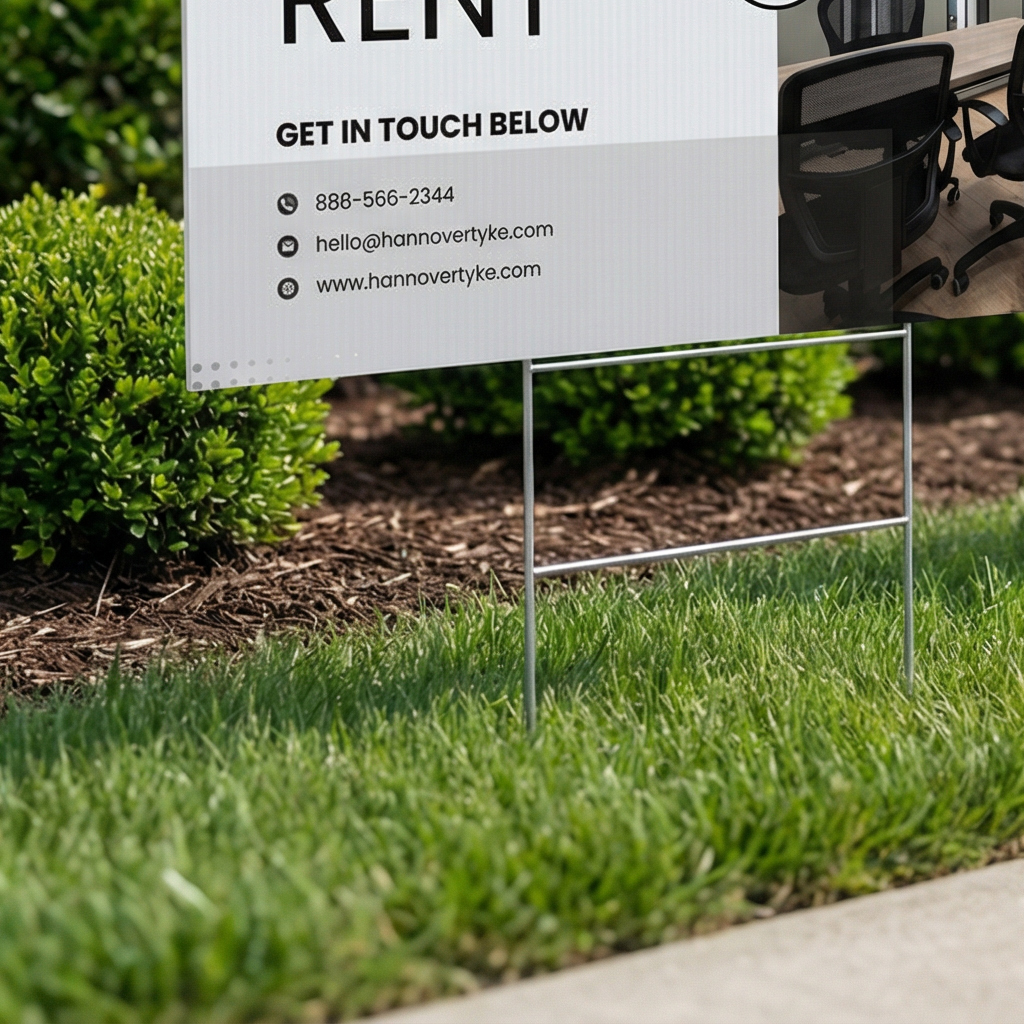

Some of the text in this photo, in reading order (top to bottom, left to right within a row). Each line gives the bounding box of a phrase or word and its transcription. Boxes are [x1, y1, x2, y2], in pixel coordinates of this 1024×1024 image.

[276, 107, 589, 148] GET IN TOUCH BELOW
[315, 185, 455, 212] 888-566-2344
[316, 223, 554, 254] hello@hannovertyke.com
[316, 263, 541, 294] www.hannovertyke.com
